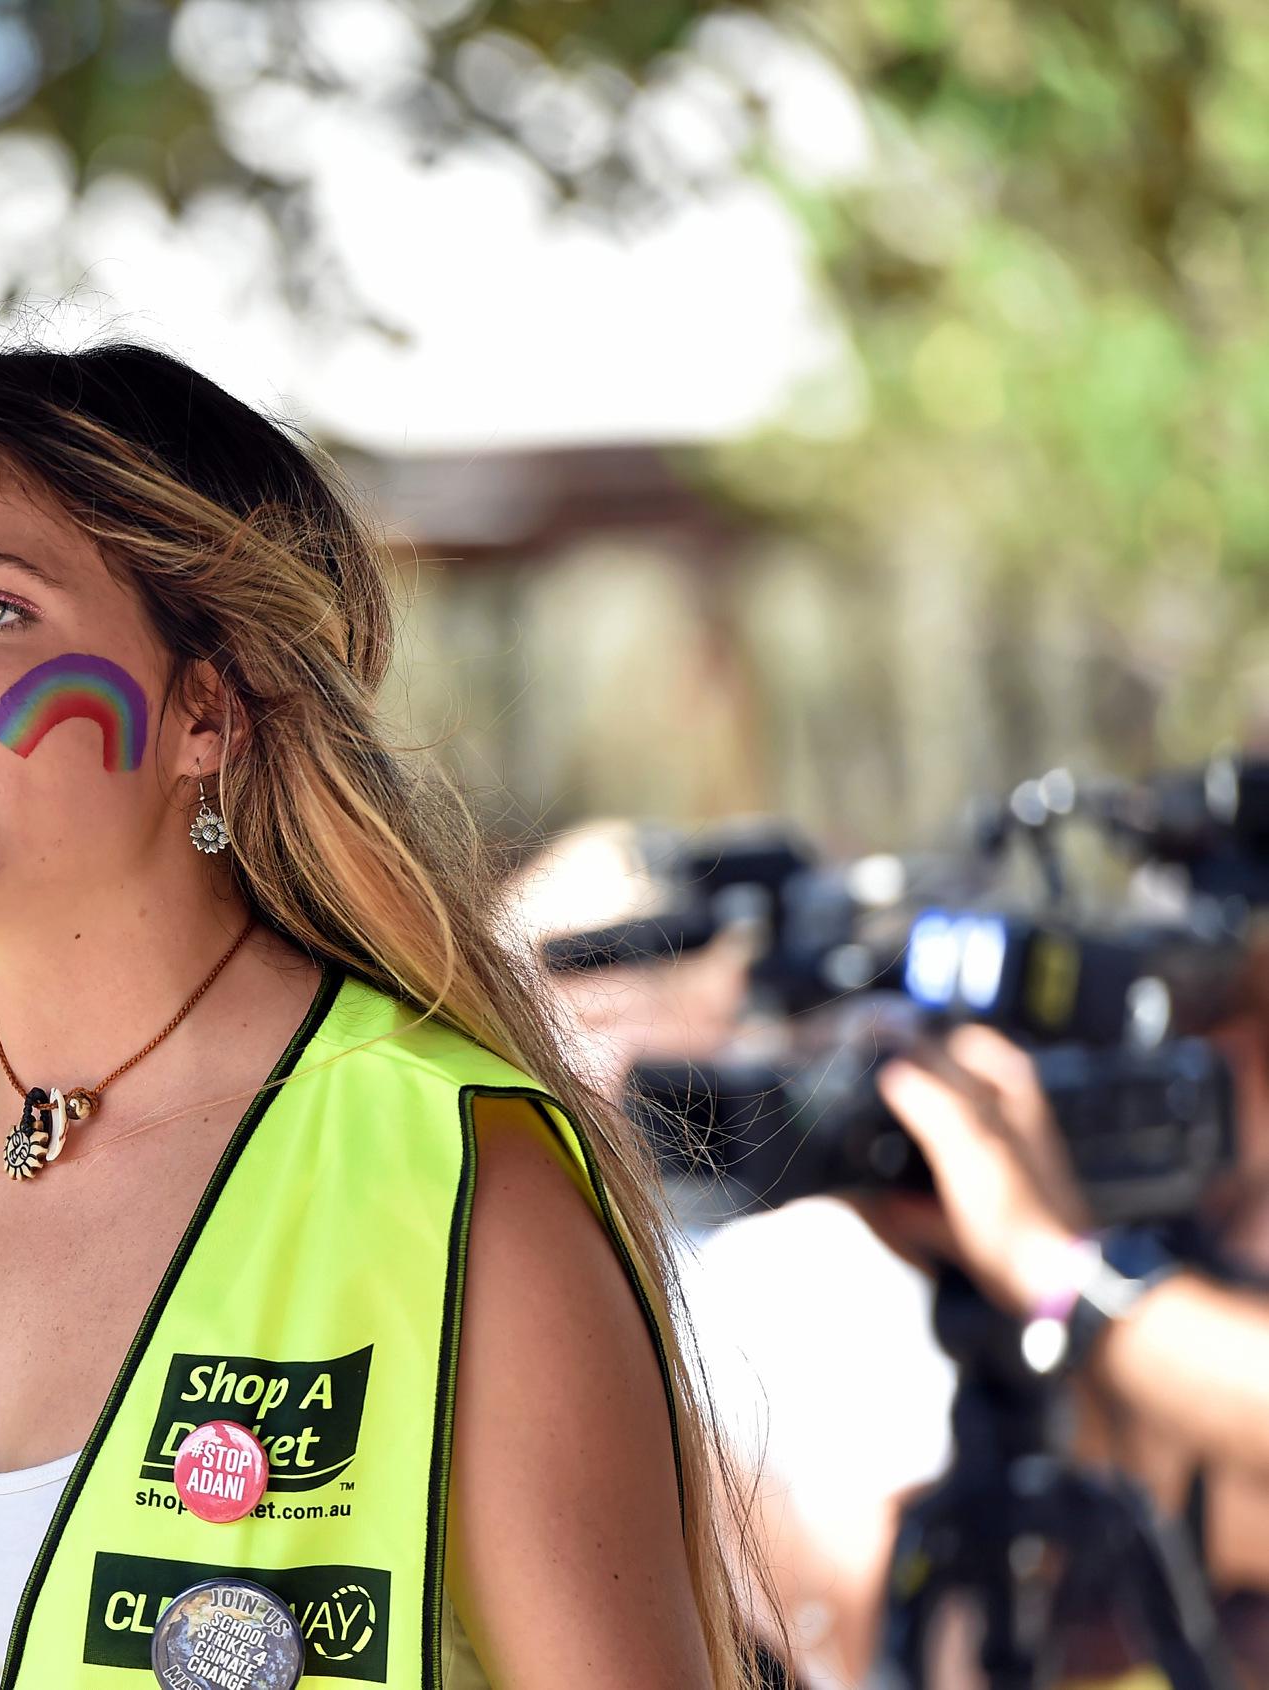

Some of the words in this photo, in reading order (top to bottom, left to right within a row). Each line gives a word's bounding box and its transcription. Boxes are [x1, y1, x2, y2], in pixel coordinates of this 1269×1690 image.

[181, 1361, 289, 1419] Shop
[299, 1373, 333, 1410] A
[190, 1440, 253, 1476] #STOP
[186, 1467, 246, 1501] ADANI
[211, 1588, 259, 1615] JOIN
[262, 1606, 291, 1637] US
[211, 1610, 267, 1649] SCHOOL
[193, 1640, 258, 1681] CLIMATE
[197, 1623, 252, 1658] STRIKE
[251, 1650, 268, 1667] 4
[186, 1656, 251, 1690] CHANGE
